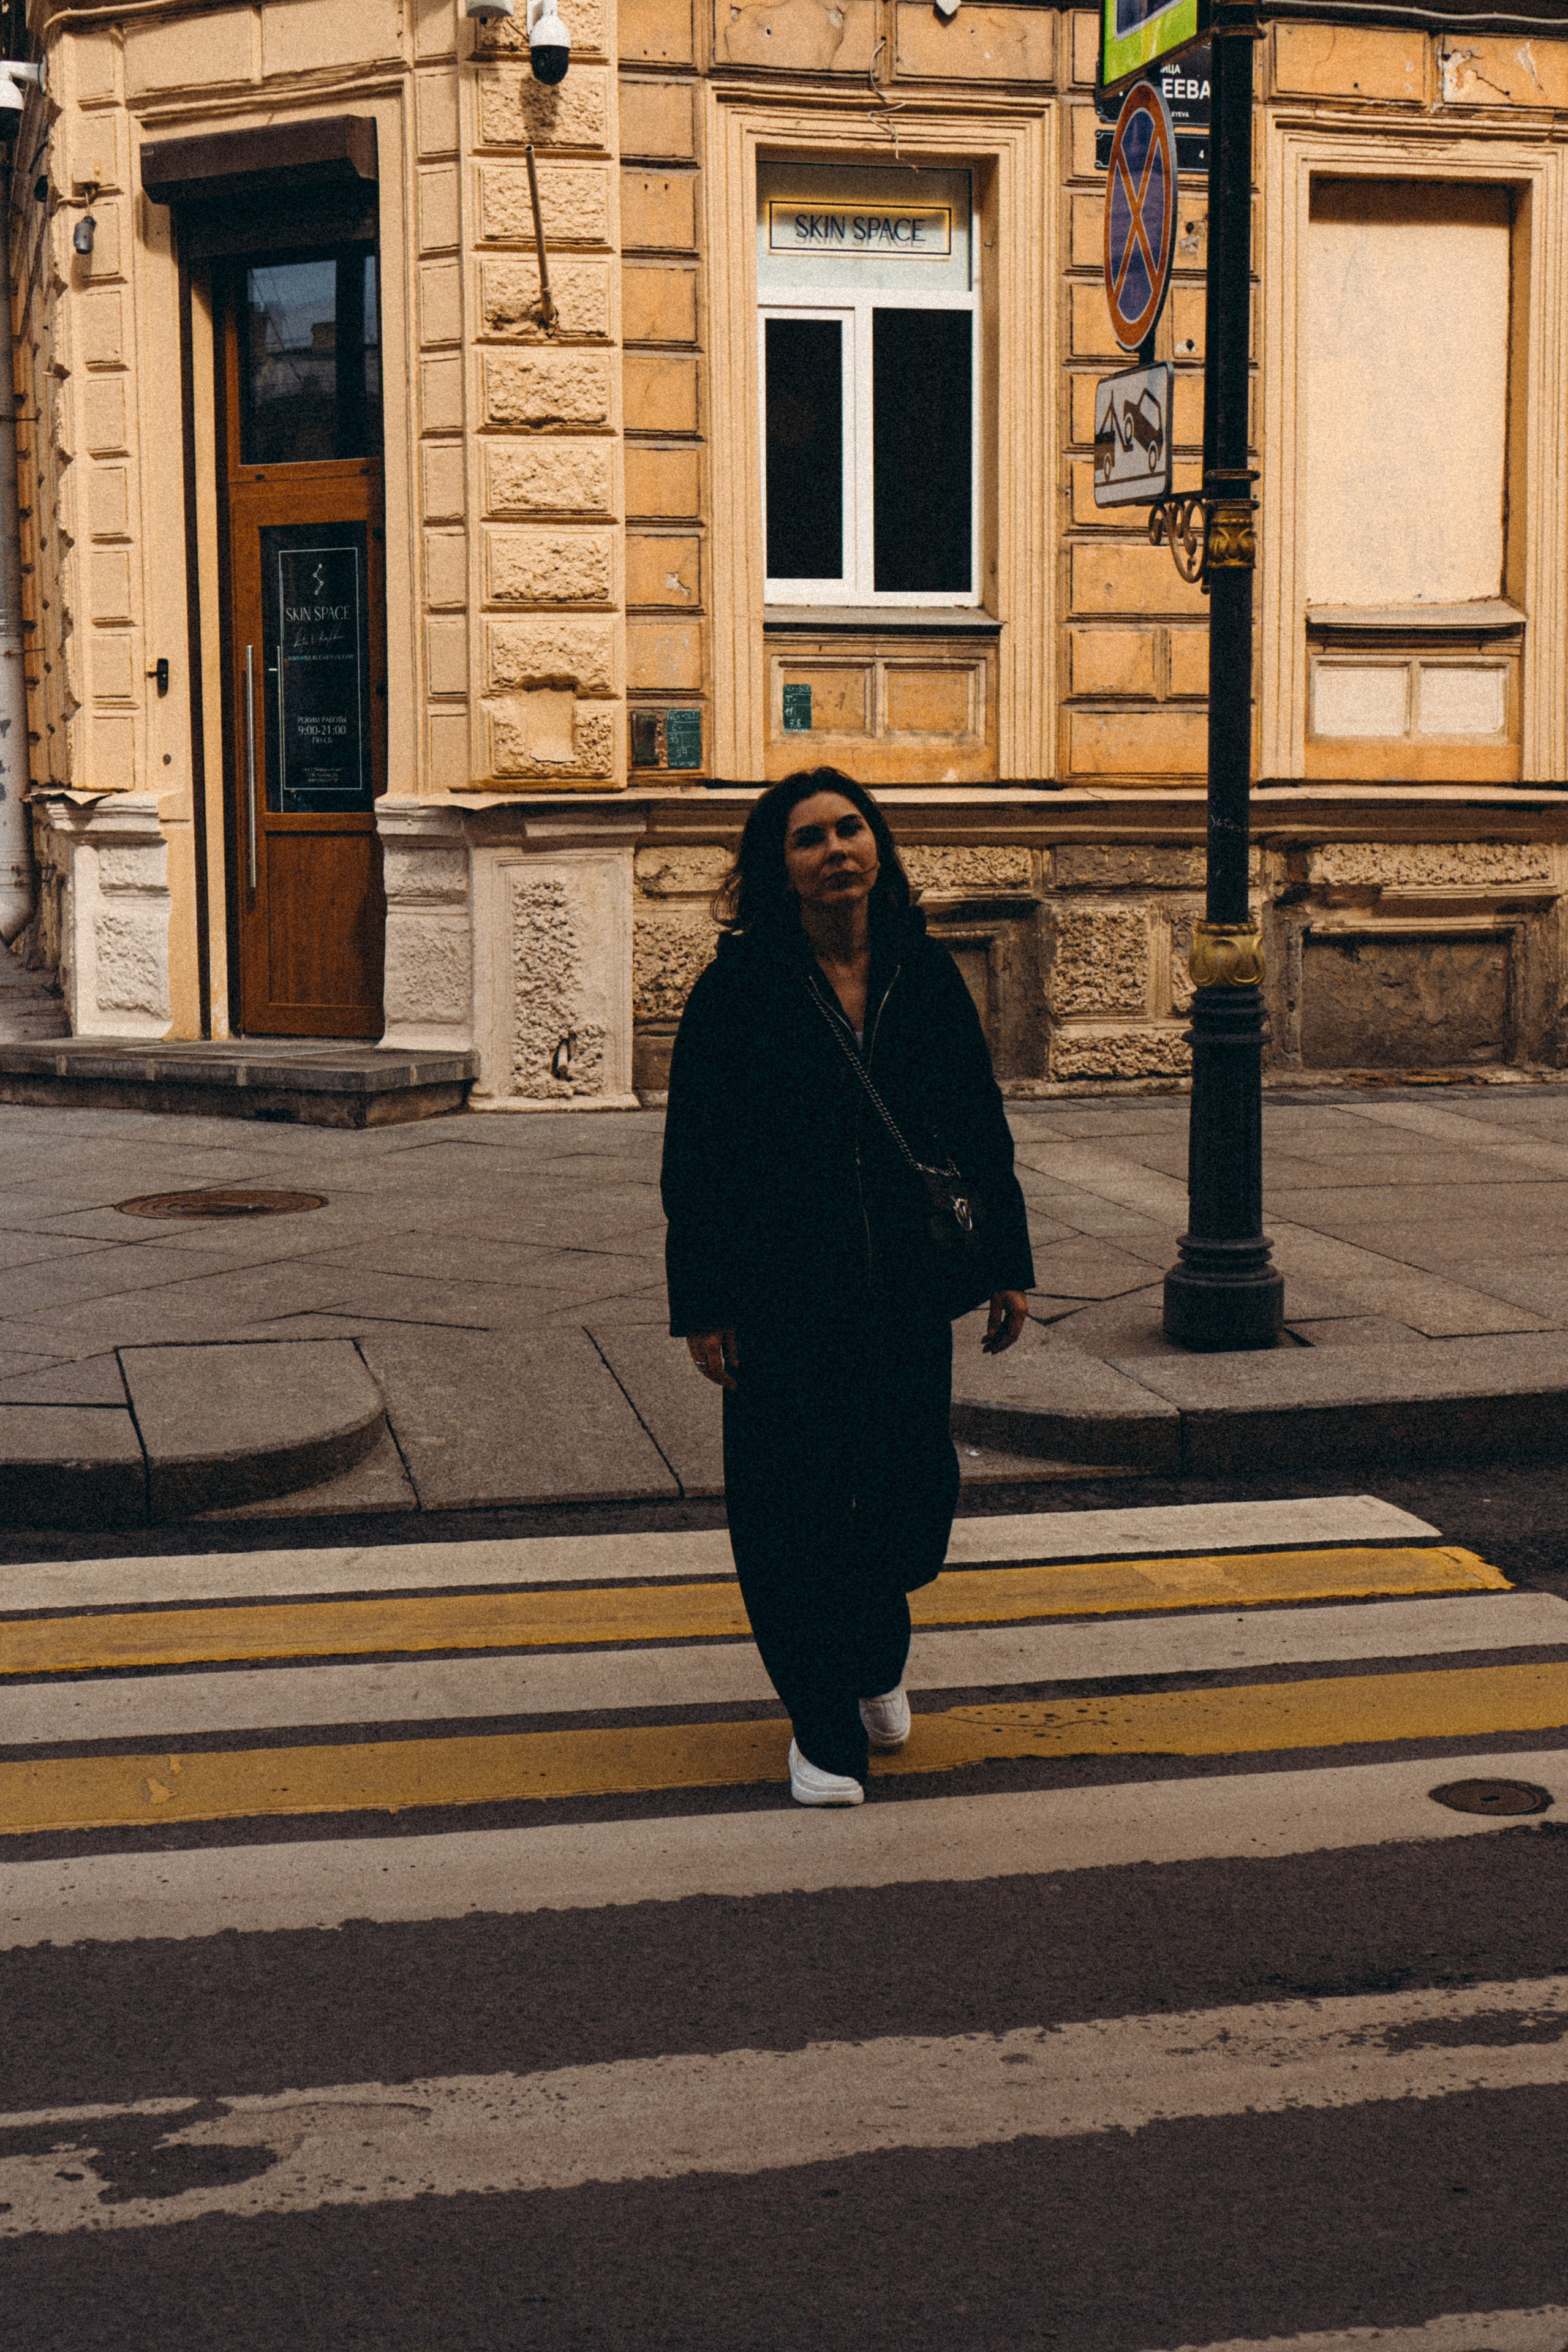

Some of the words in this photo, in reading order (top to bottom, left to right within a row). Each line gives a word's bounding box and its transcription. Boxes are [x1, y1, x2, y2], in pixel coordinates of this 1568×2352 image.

[1160, 64, 1181, 75] ИЦА
[1163, 78, 1210, 99] ЕЕВА
[796, 214, 846, 239] SKIN
[853, 217, 926, 241] SPACE
[285, 606, 311, 622] SKIN
[314, 605, 351, 621] SPACE
[298, 725, 347, 736] 9:00-21:00
